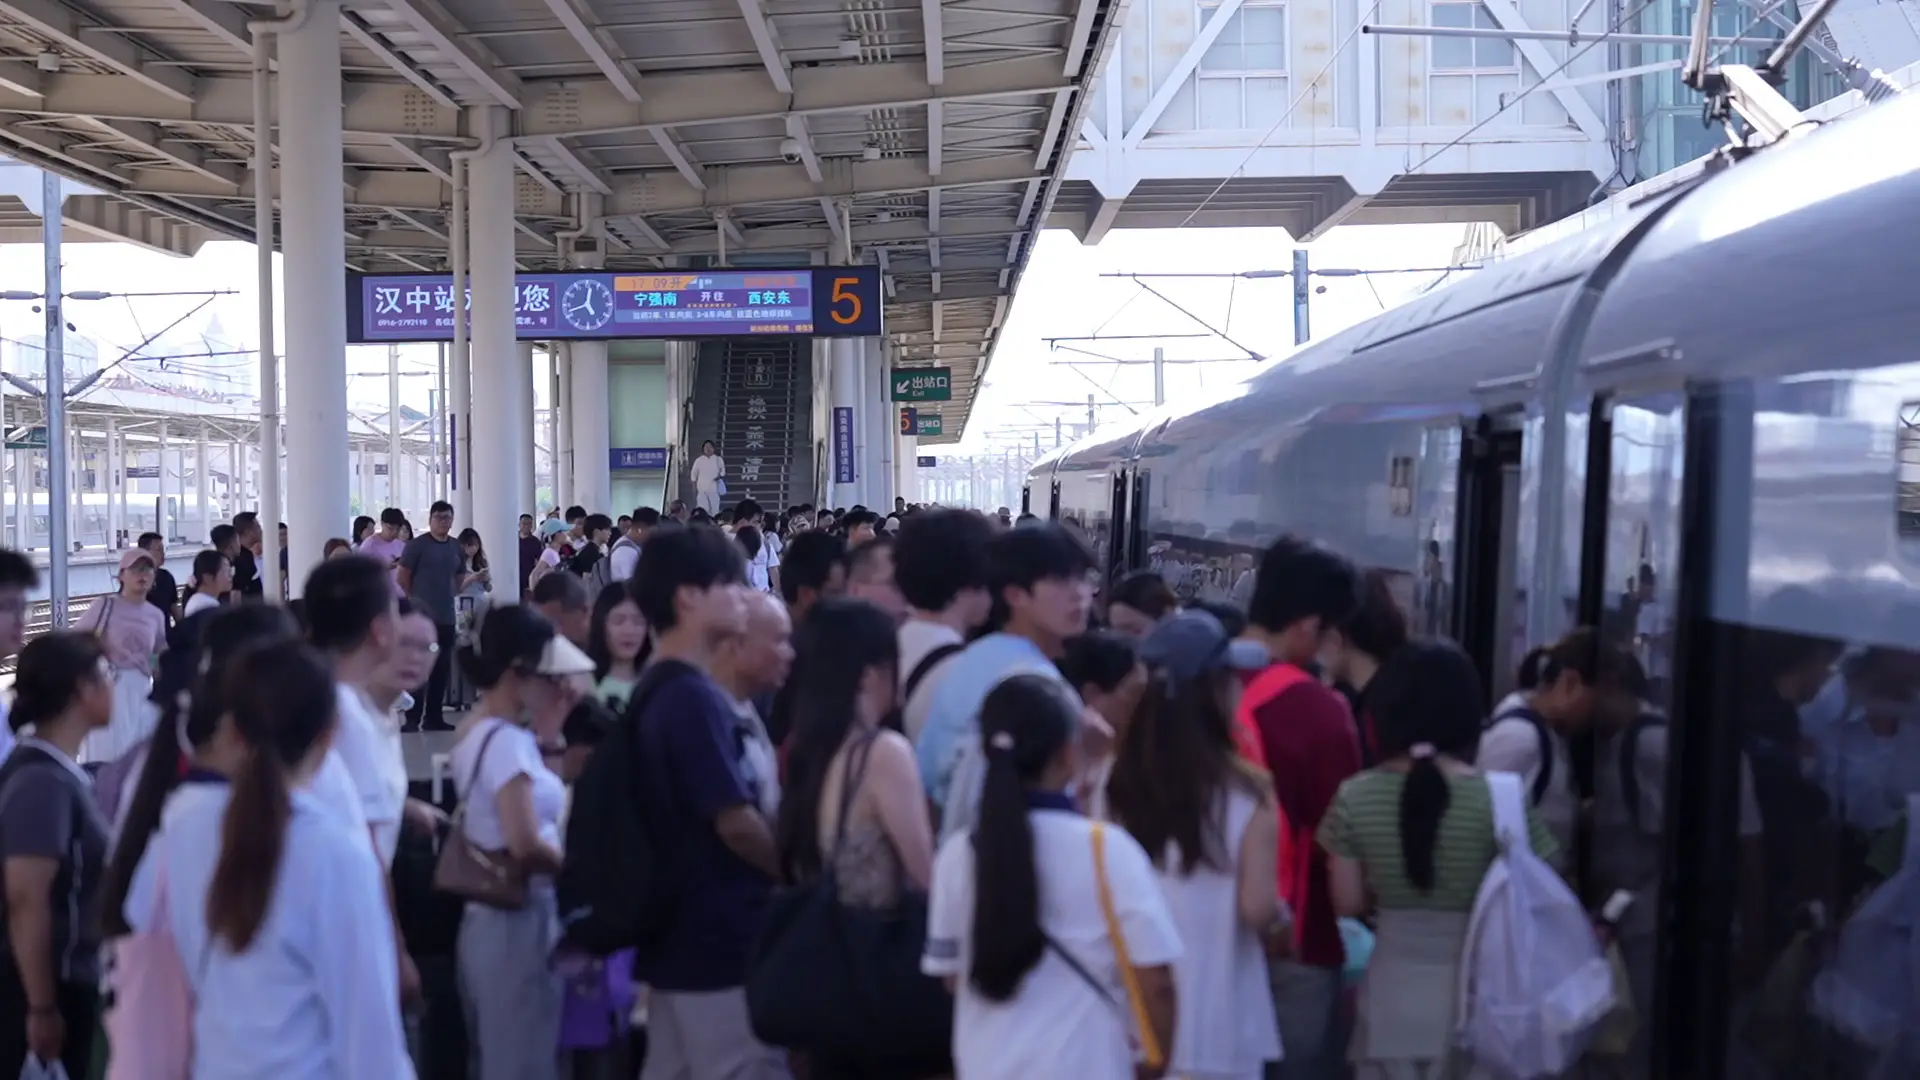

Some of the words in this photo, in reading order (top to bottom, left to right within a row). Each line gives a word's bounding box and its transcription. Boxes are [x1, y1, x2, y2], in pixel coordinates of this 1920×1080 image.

[375, 284, 550, 314] 汉中站您
[634, 291, 677, 307] 宁强南
[701, 291, 724, 302] 开往
[748, 290, 791, 305] 西安东
[830, 277, 862, 325] 5
[912, 376, 948, 389] 出站口
[901, 411, 910, 431] 5
